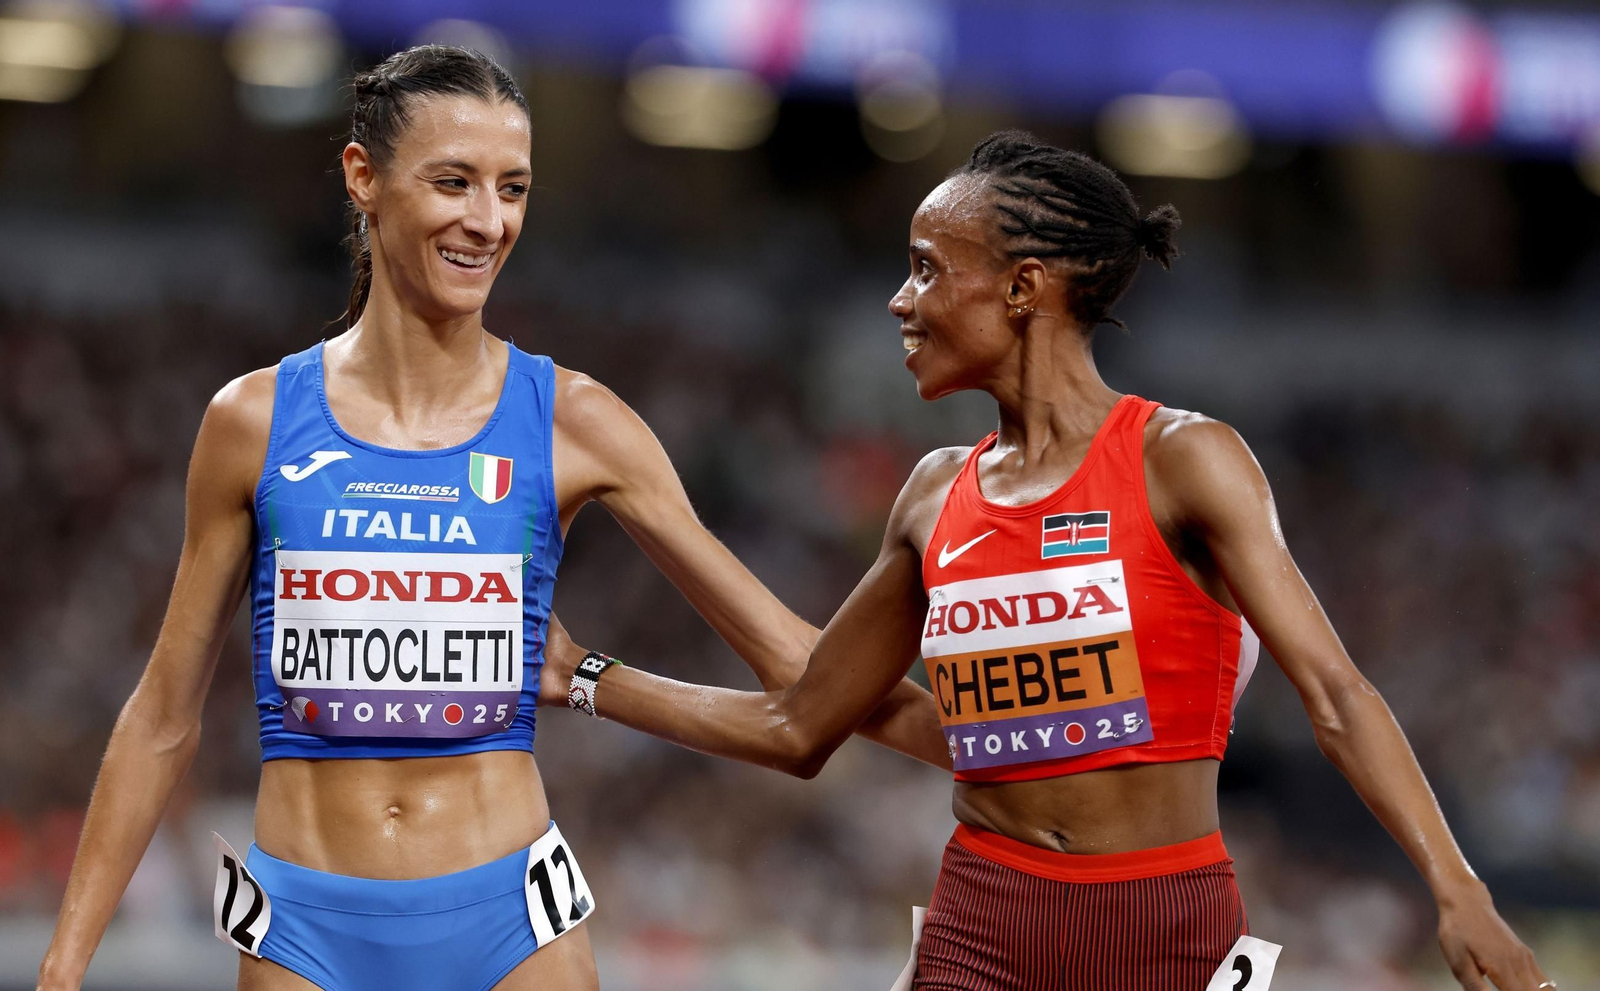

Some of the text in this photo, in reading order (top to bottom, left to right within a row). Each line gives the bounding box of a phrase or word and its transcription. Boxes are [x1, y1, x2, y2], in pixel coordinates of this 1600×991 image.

[345, 482, 460, 497] FRECCIAROSSA
[321, 509, 477, 545] ITALIA
[279, 568, 518, 603] HONDA
[924, 584, 1124, 639] HONDA
[281, 628, 513, 682] BATTOCLETTI
[936, 640, 1120, 718] CHEBET
[472, 704, 508, 724] 25
[220, 854, 264, 950] 12
[529, 844, 591, 936] 12
